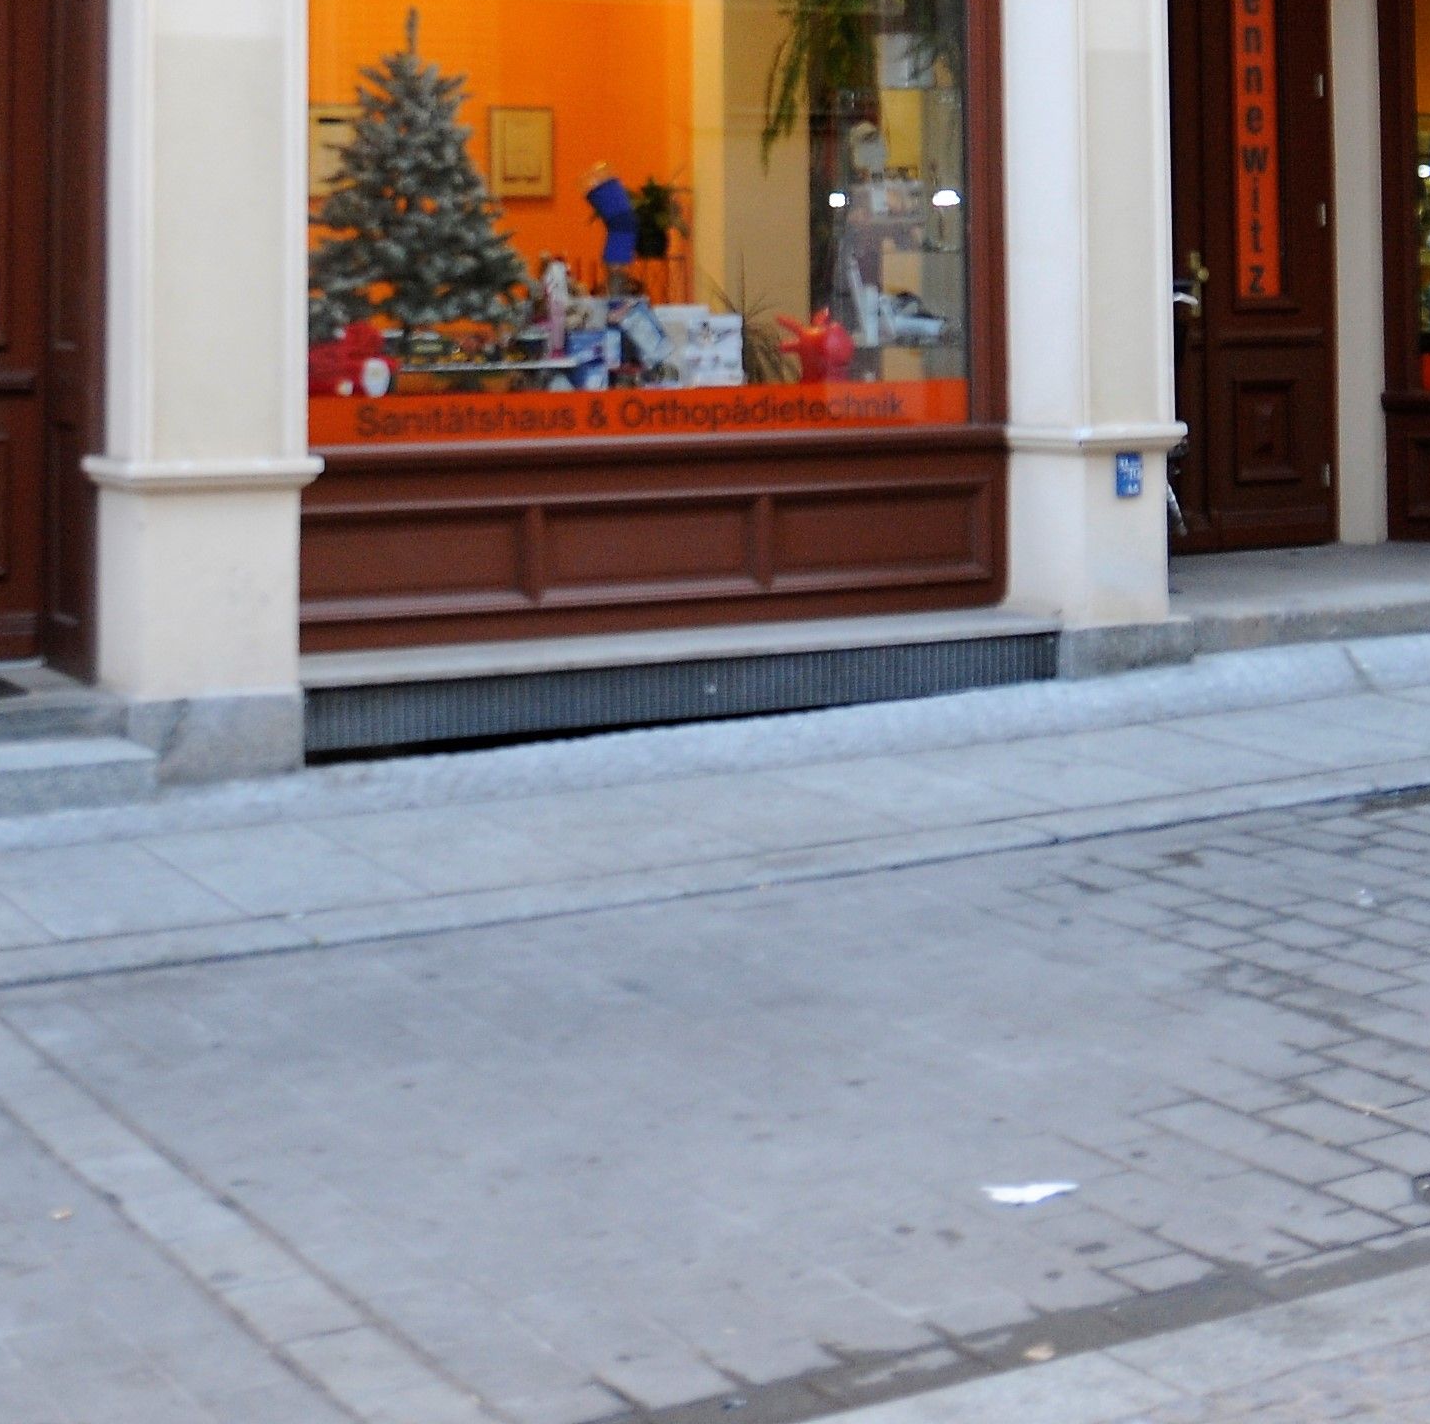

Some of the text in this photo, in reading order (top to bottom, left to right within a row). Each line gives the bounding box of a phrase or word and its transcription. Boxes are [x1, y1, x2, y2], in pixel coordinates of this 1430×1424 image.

[356, 393, 903, 437] Sanitätshaus & Orthopädietechnik
